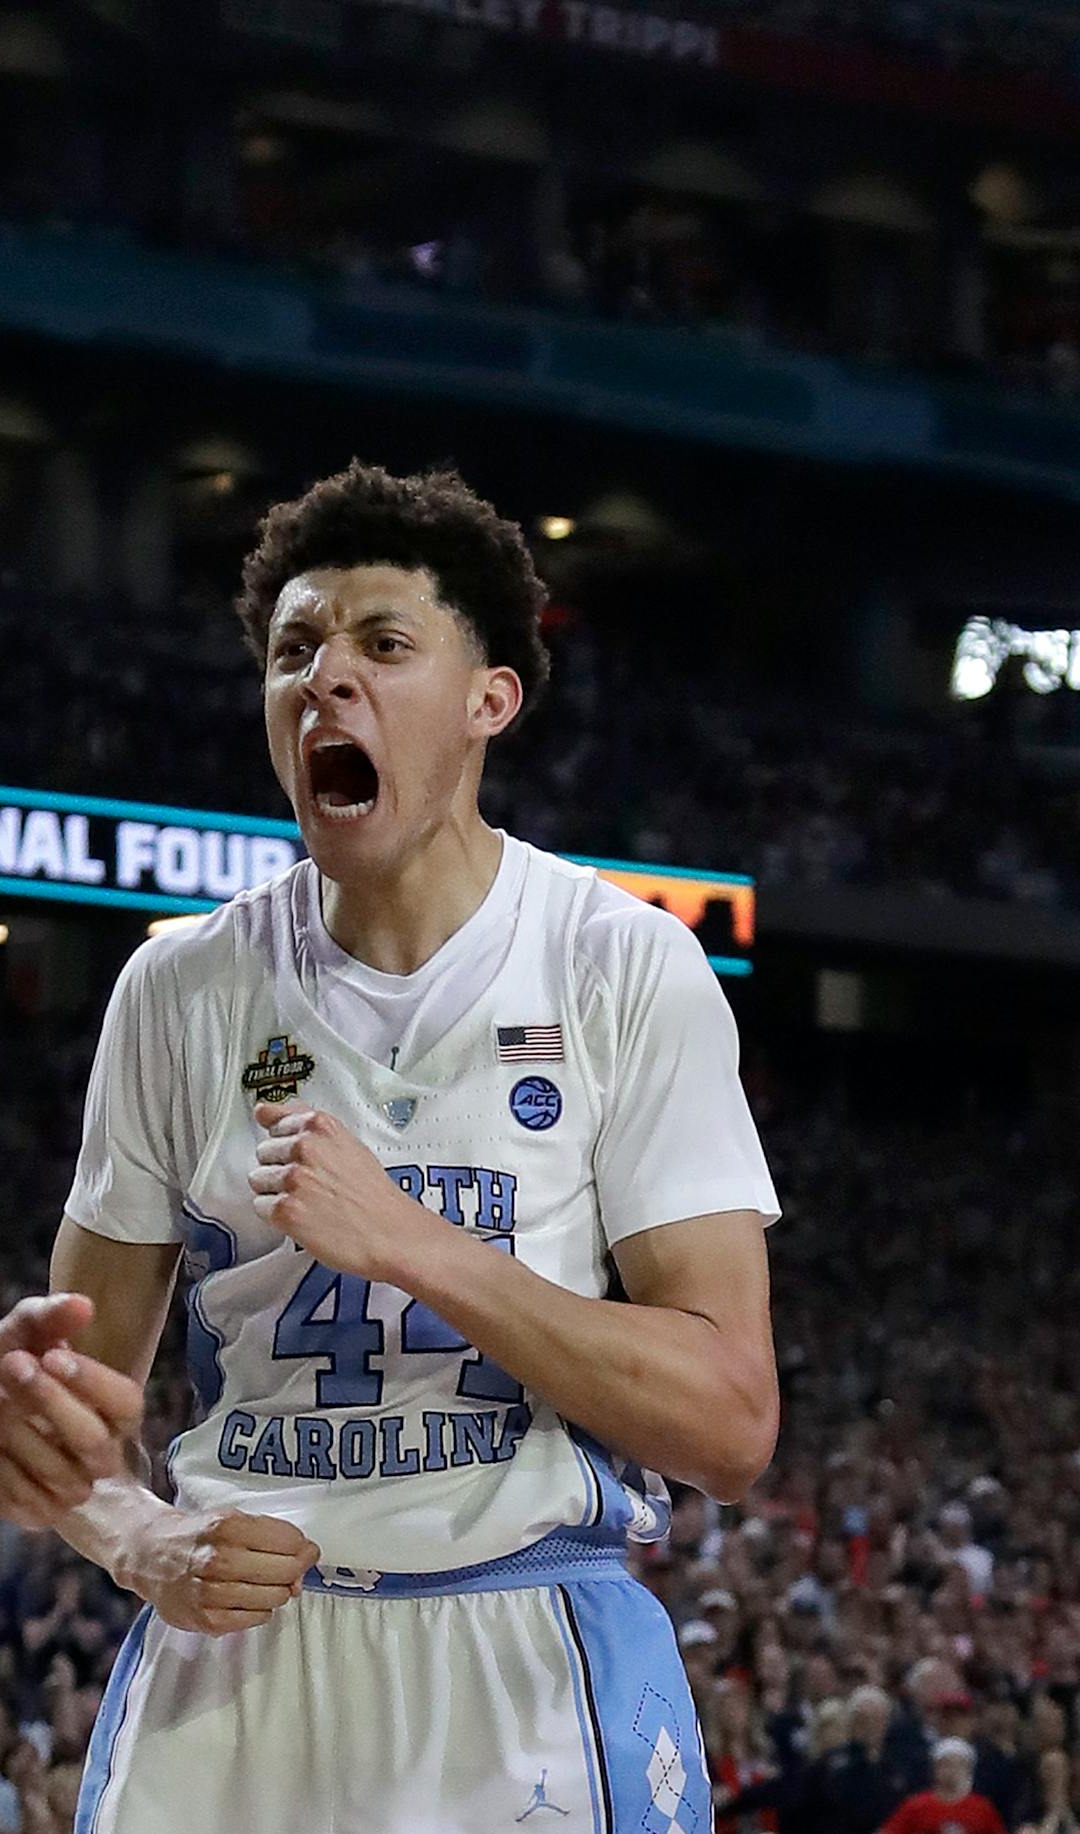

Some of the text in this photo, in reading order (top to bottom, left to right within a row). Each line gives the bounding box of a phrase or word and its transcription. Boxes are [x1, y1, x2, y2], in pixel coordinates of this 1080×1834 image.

[116, 820, 297, 900] FOUR
[517, 1093, 558, 1107] ACC
[384, 1163, 518, 1232] RTH
